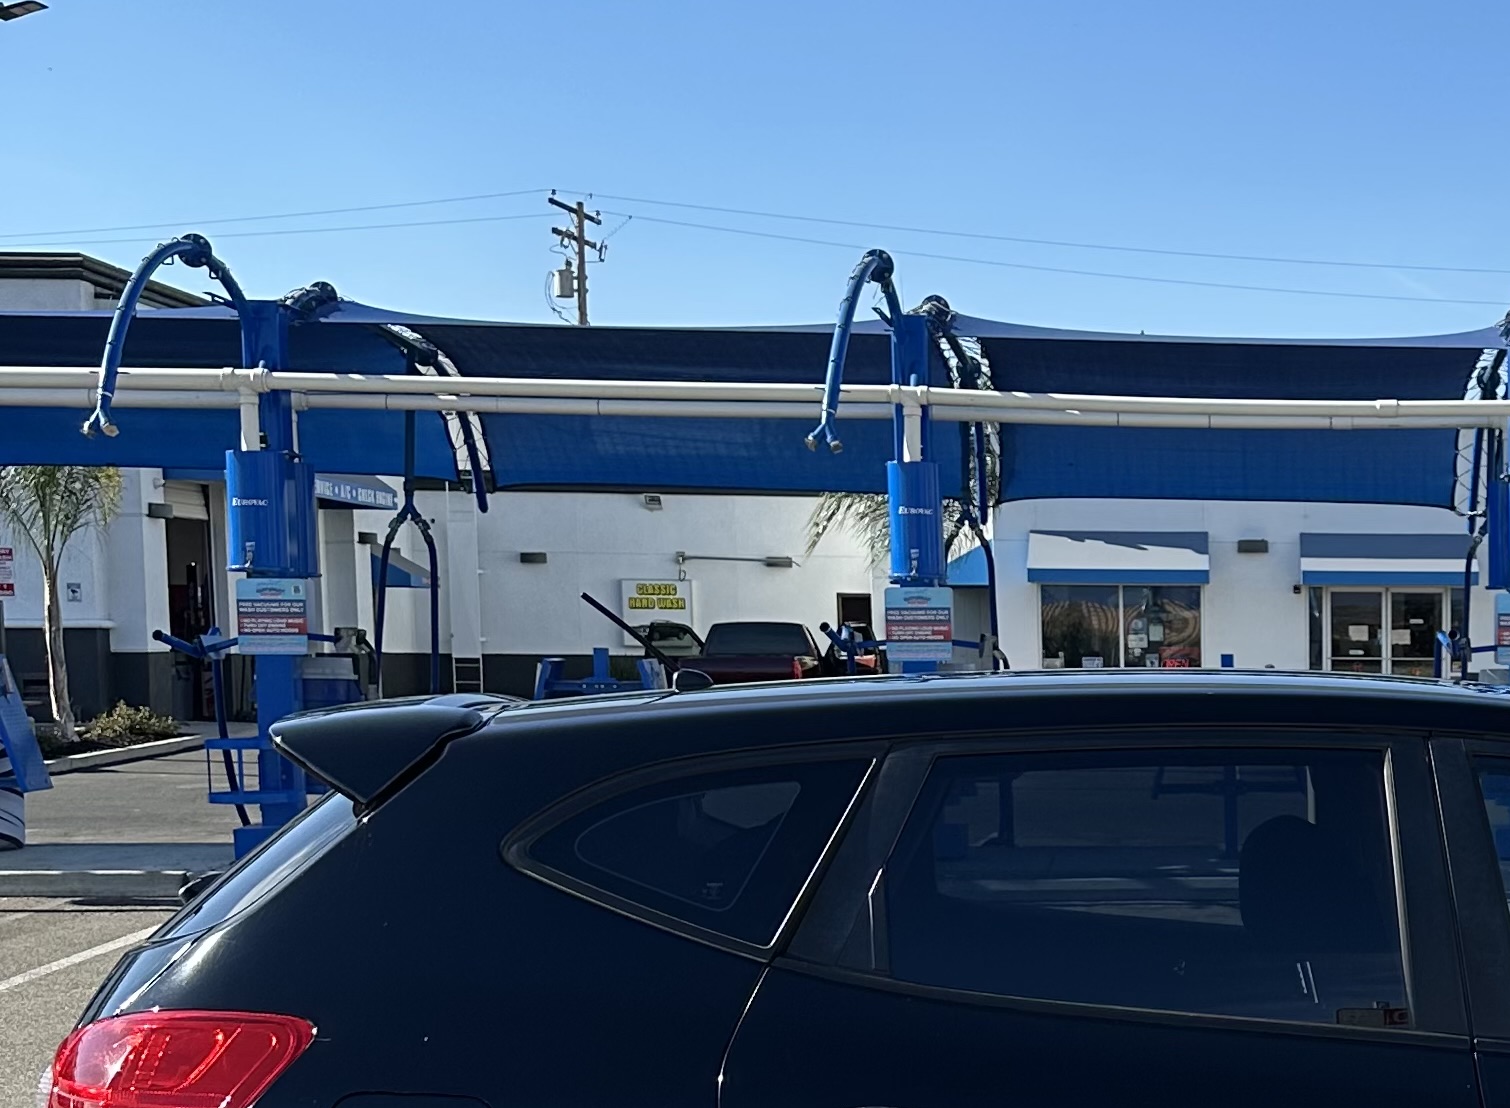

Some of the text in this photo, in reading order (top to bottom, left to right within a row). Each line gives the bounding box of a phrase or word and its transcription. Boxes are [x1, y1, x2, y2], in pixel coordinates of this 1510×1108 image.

[636, 583, 678, 596] CLASSIC
[628, 597, 687, 610] HAND WASH
